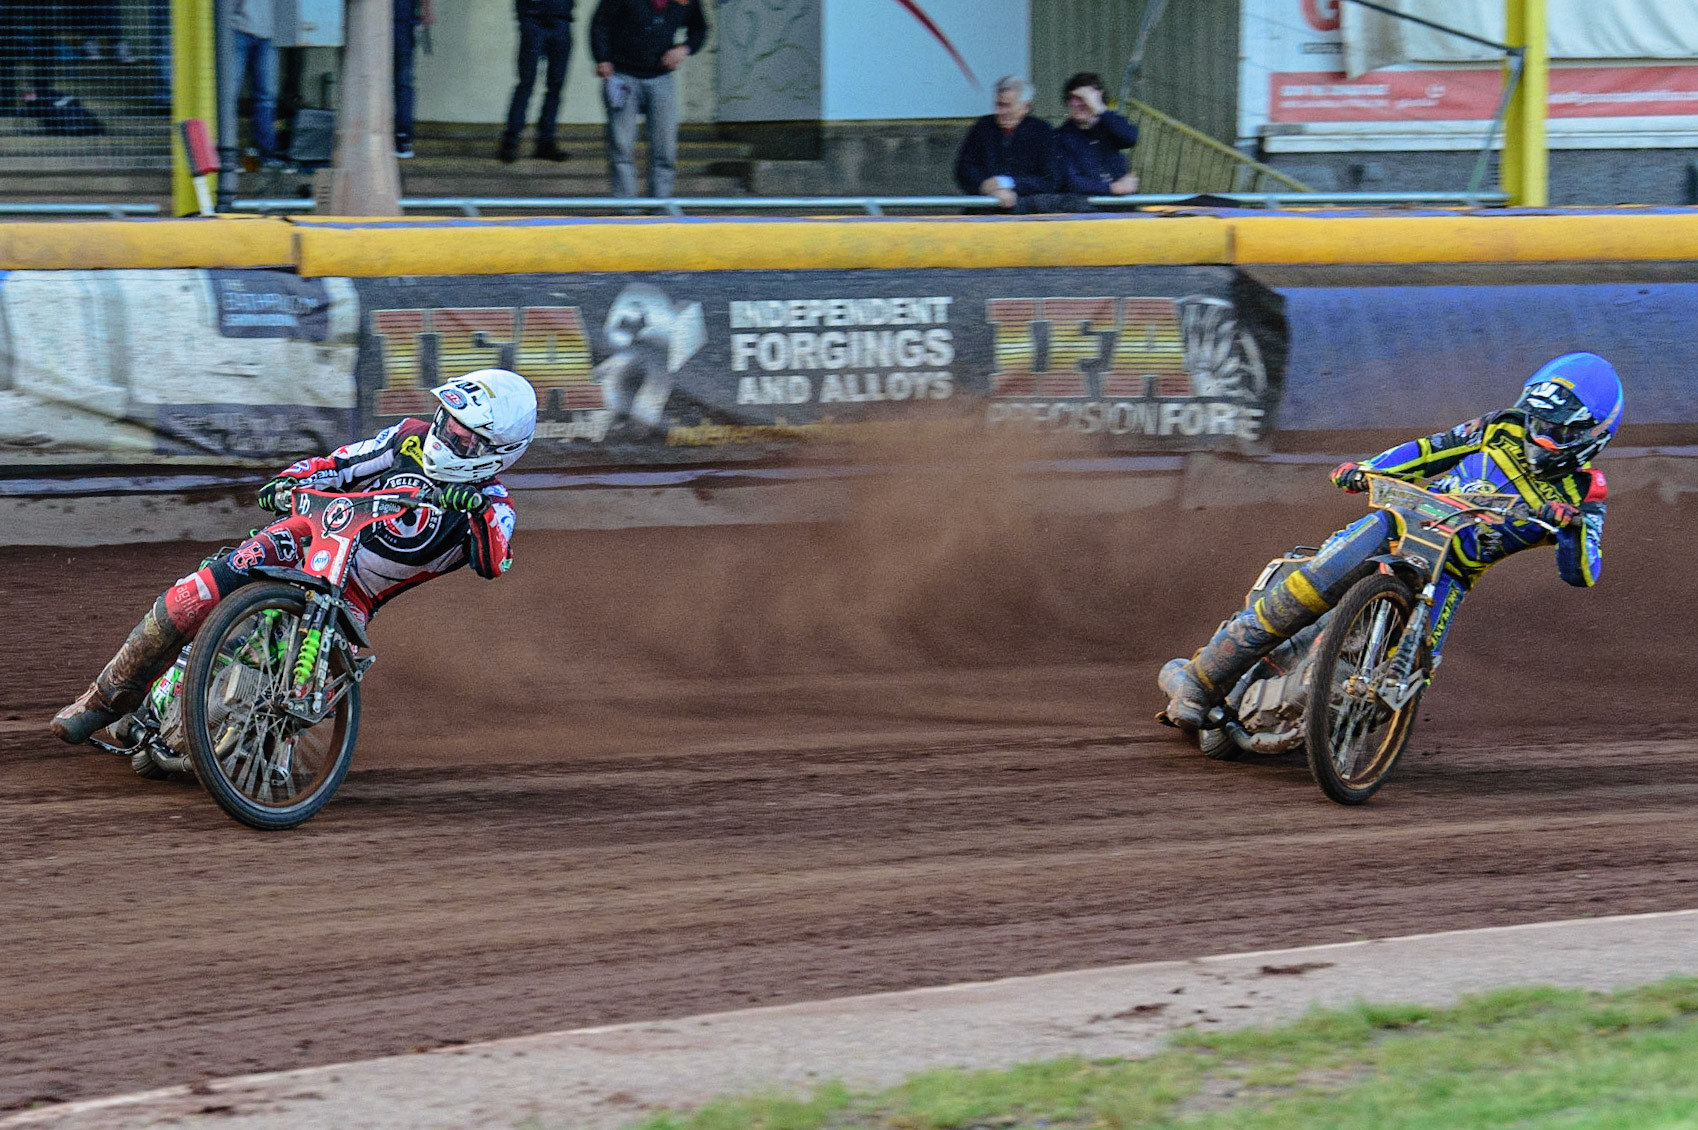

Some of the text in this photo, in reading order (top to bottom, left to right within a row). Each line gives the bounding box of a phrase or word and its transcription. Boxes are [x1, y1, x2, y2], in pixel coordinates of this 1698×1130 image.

[729, 297, 953, 328] INDEPENDENT
[730, 328, 955, 371] FORGINGS
[985, 297, 1196, 398] IFA
[736, 375, 812, 404] AND
